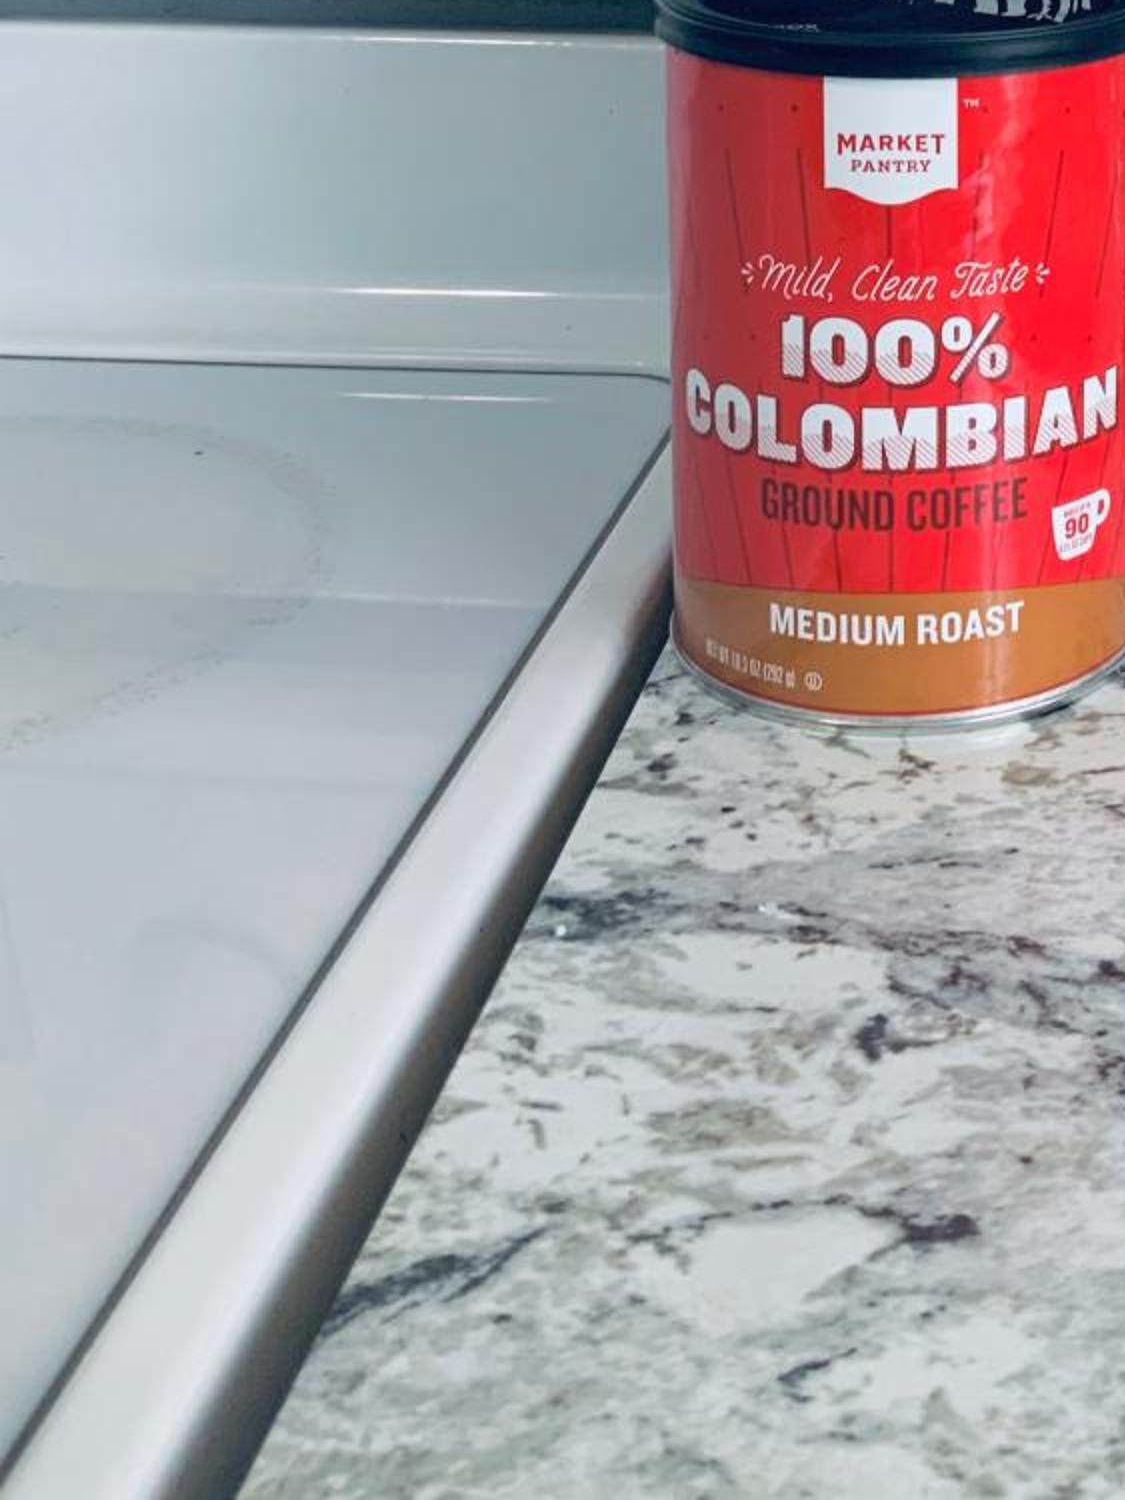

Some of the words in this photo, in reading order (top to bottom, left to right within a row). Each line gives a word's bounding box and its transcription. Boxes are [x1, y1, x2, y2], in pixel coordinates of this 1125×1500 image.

[836, 132, 945, 156] MARKET
[850, 158, 932, 174] PANTRY
[758, 254, 842, 303] Mild,
[852, 259, 939, 301] Clean
[950, 256, 1029, 299] Taste
[780, 312, 1010, 386] 100%
[684, 366, 1120, 472] COLOMBIAN
[761, 478, 894, 532] GROUND
[907, 476, 1029, 532] COFFEE
[1064, 512, 1090, 540] 90
[769, 603, 905, 646] MEDIUM
[917, 601, 1025, 644] ROAST
